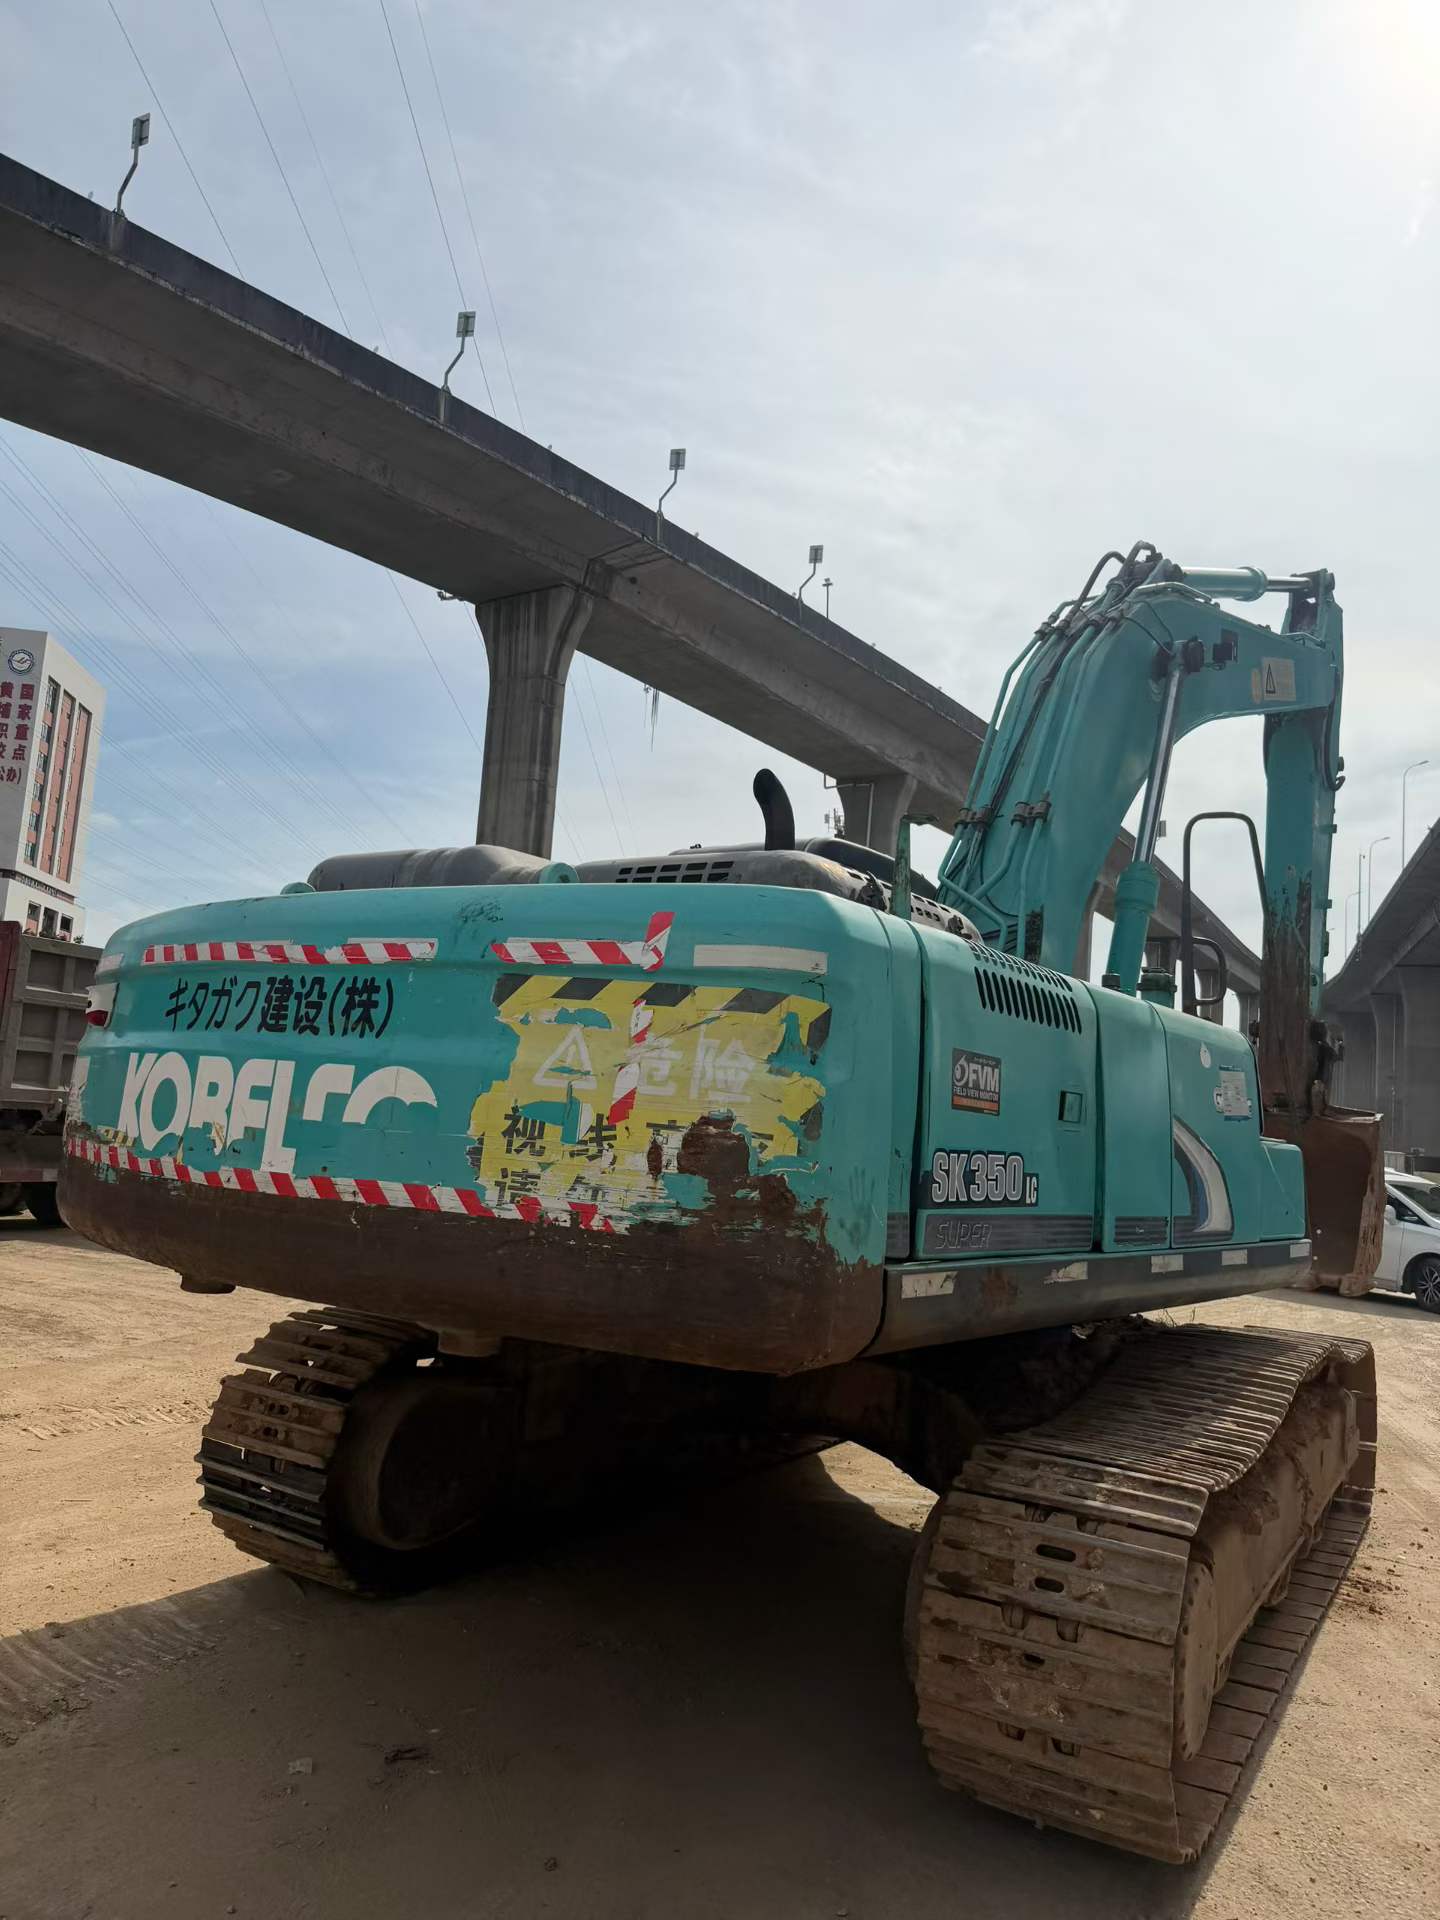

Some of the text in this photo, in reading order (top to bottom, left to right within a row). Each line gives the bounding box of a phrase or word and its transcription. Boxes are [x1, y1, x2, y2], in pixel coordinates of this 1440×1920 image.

[12, 683, 35, 761] 国家重点
[627, 1024, 755, 1105] 危险
[931, 1151, 1038, 1204] SK350 LC
[936, 1221, 993, 1249] SUPER
